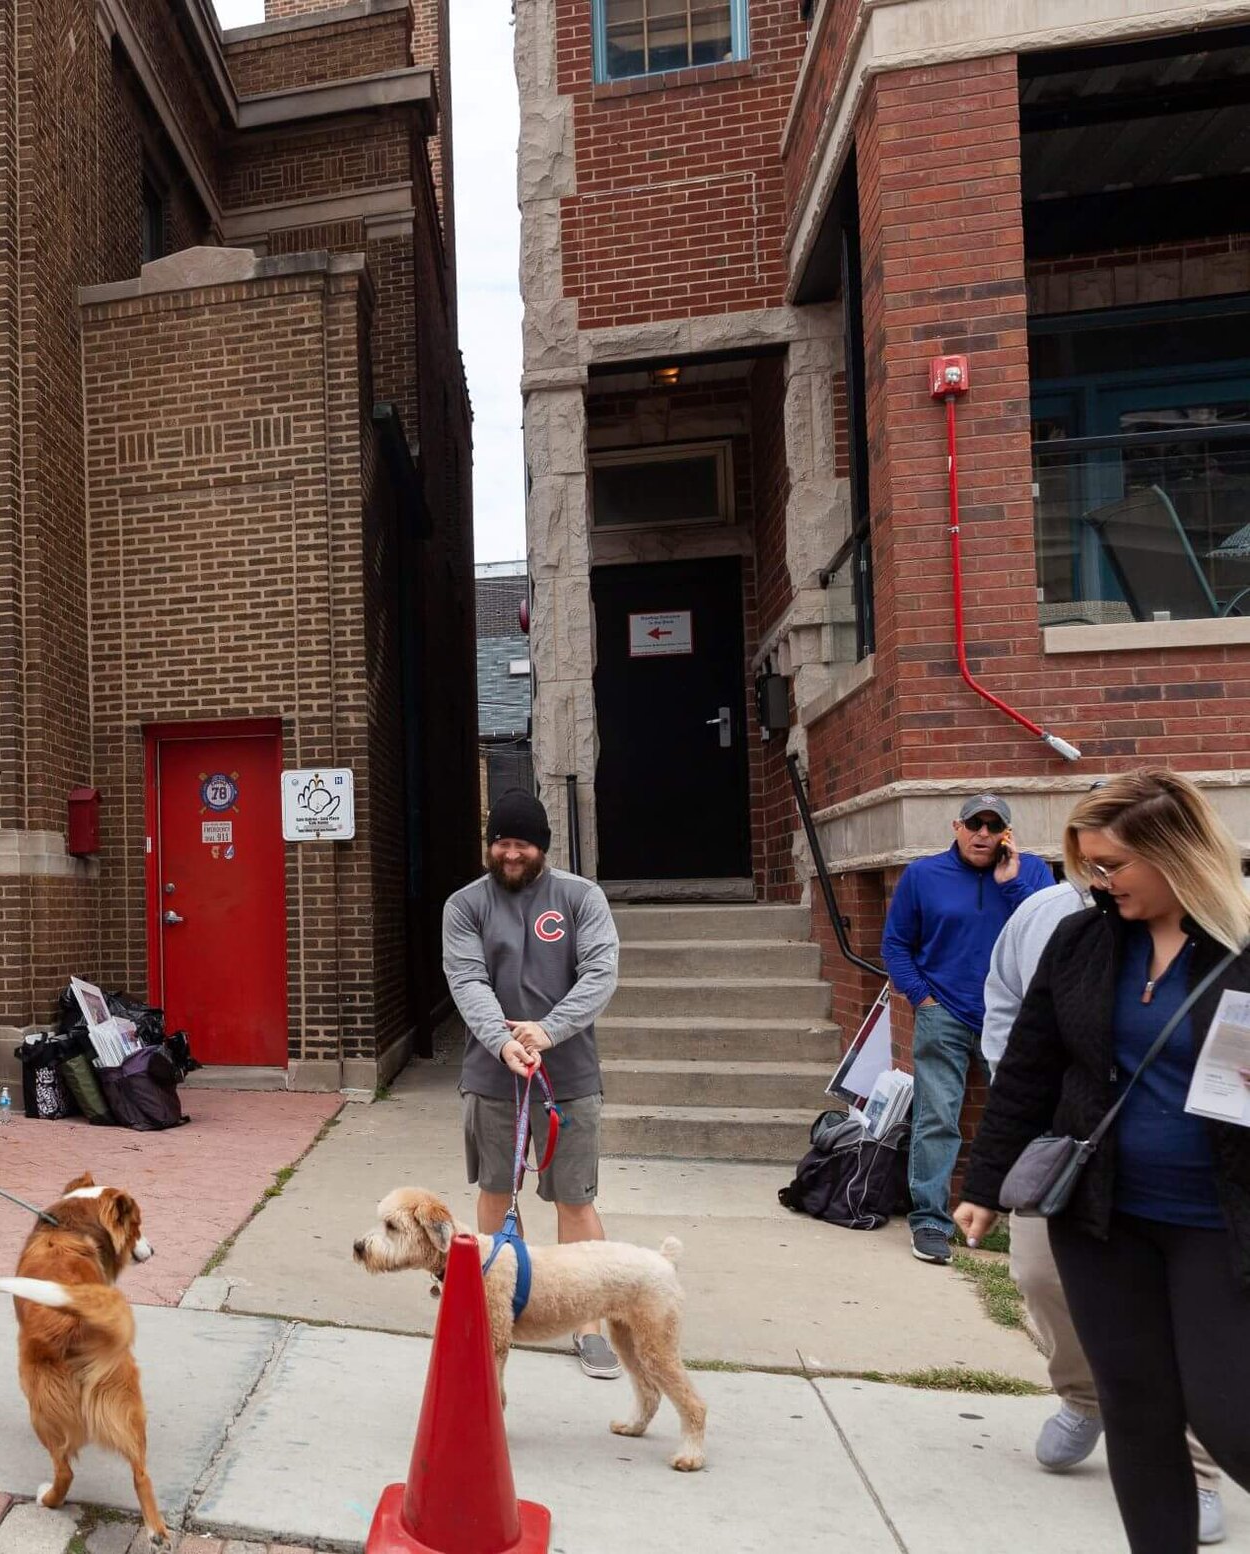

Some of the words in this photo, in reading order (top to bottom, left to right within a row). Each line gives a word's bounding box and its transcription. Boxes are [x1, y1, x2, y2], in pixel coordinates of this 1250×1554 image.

[211, 787, 227, 800] 78
[217, 832, 229, 841] 911
[535, 911, 565, 942] C
